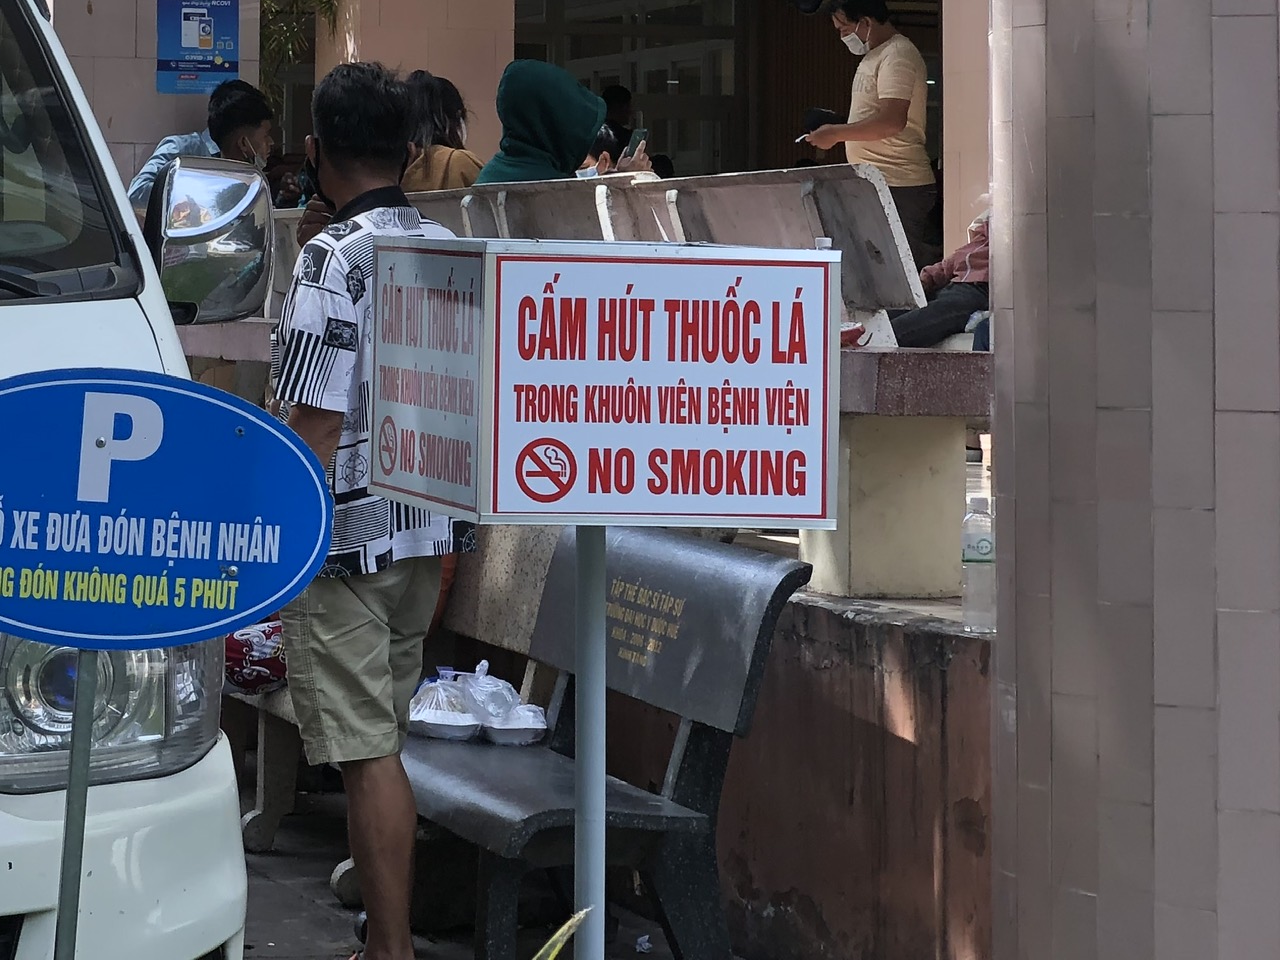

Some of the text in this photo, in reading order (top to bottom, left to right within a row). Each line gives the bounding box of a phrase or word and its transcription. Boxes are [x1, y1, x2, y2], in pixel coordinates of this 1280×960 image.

[381, 263, 474, 356] CẤM HÚT THUỐC LÁ
[517, 273, 808, 365] CẤM HÚT THUỐC LÁ
[379, 362, 474, 425] TRONG KHUÔN VIÊN BỆNH VIỆN
[513, 377, 810, 435] TRONG KHUÔN VIÊN BỆNH VIỆN
[77, 392, 164, 502] P
[400, 428, 472, 487] NO SMOKING
[588, 448, 807, 497] NO SMOKING
[10, 510, 40, 550] XE
[46, 510, 91, 553] ĐƯA
[98, 508, 146, 556] ĐÓN
[150, 511, 212, 567] BỆNH
[217, 516, 281, 564] NHÂN
[19, 563, 59, 600] ĐÓN
[63, 566, 127, 604] KHÔNG
[132, 570, 169, 608] QUÁ
[173, 577, 186, 608] 5
[190, 573, 239, 610] PHÚT
